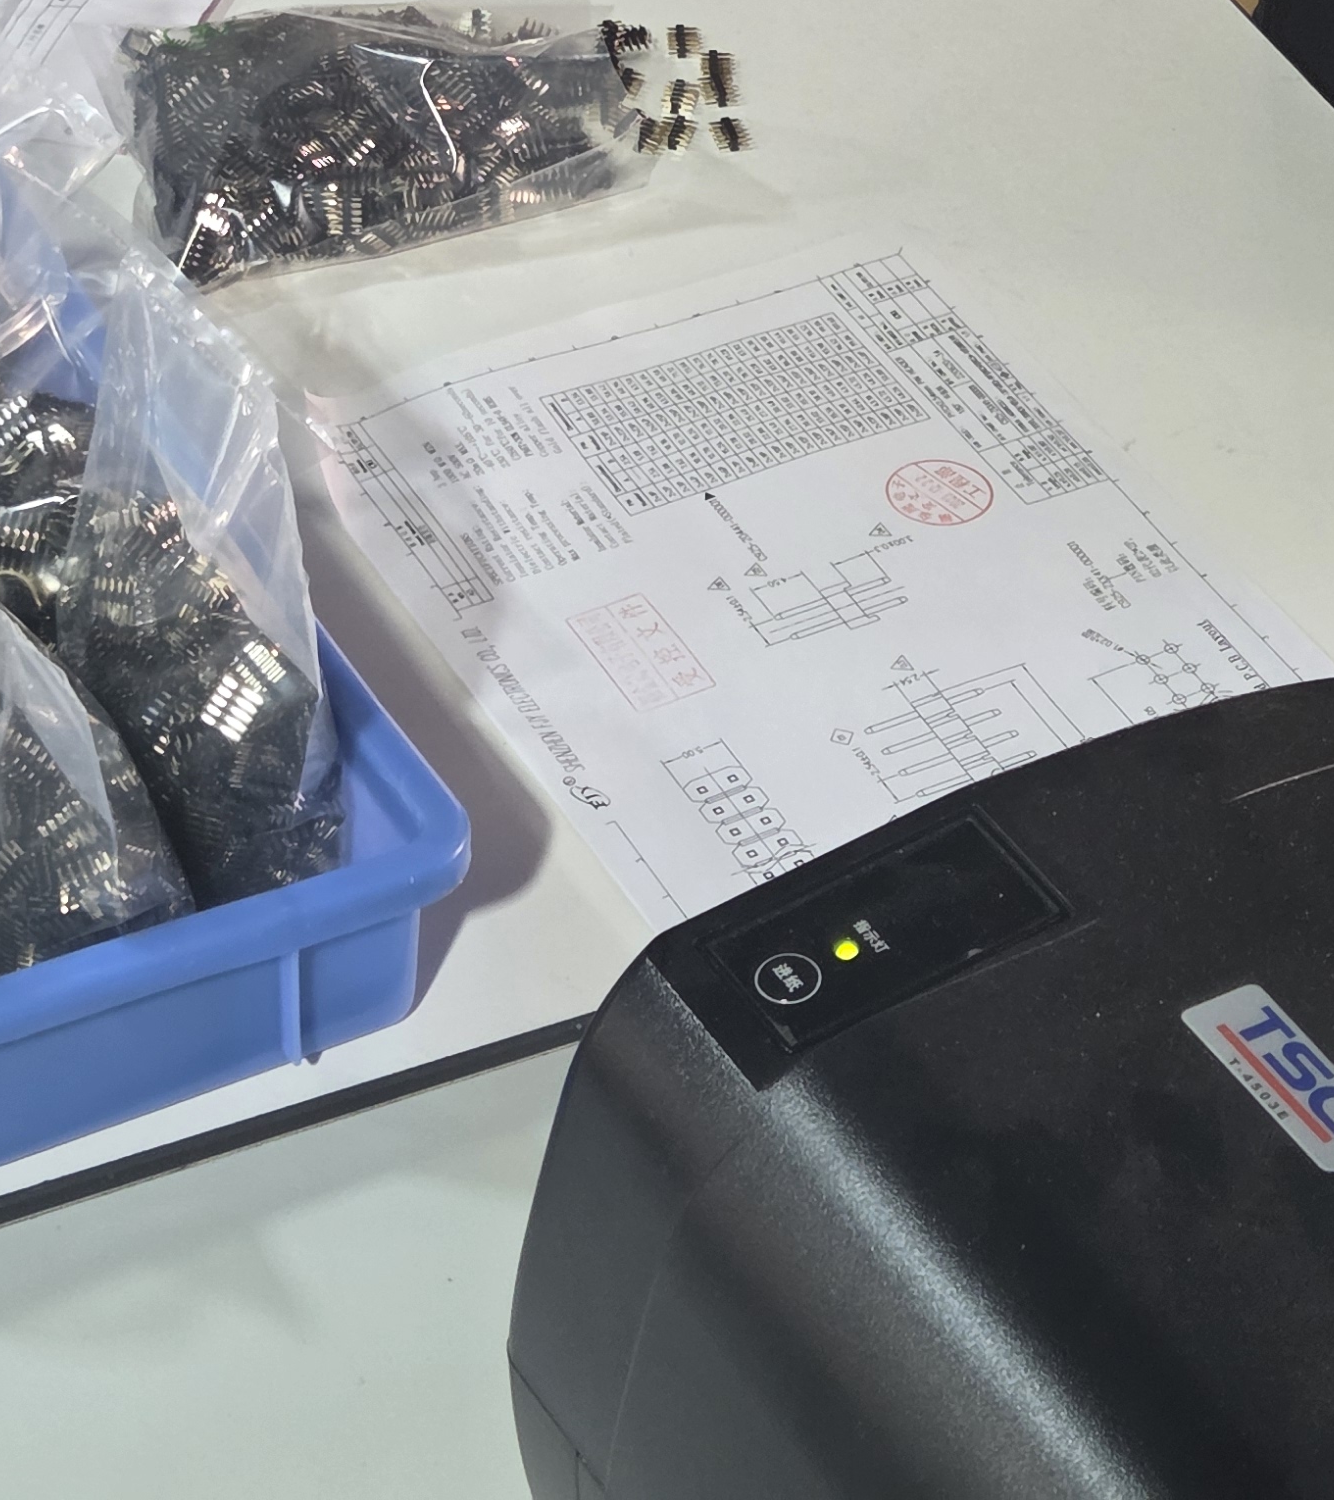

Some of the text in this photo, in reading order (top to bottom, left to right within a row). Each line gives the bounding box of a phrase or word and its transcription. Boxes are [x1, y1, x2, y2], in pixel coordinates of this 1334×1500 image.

[524, 432, 551, 457] Copper
[932, 461, 987, 502] 工程部
[536, 530, 569, 566] Operating
[593, 522, 620, 549] Contact
[459, 531, 504, 586] SPECIFICATIONS
[490, 553, 517, 582] Current
[507, 534, 542, 574] Dielectric
[529, 542, 555, 570] Contact
[615, 598, 704, 690] 受控文件
[1194, 618, 1234, 652] Layout
[569, 778, 611, 814] FJY
[849, 915, 892, 956] 指示灯
[769, 959, 807, 994] 进纸
[1224, 1057, 1292, 1120] T-4503E
